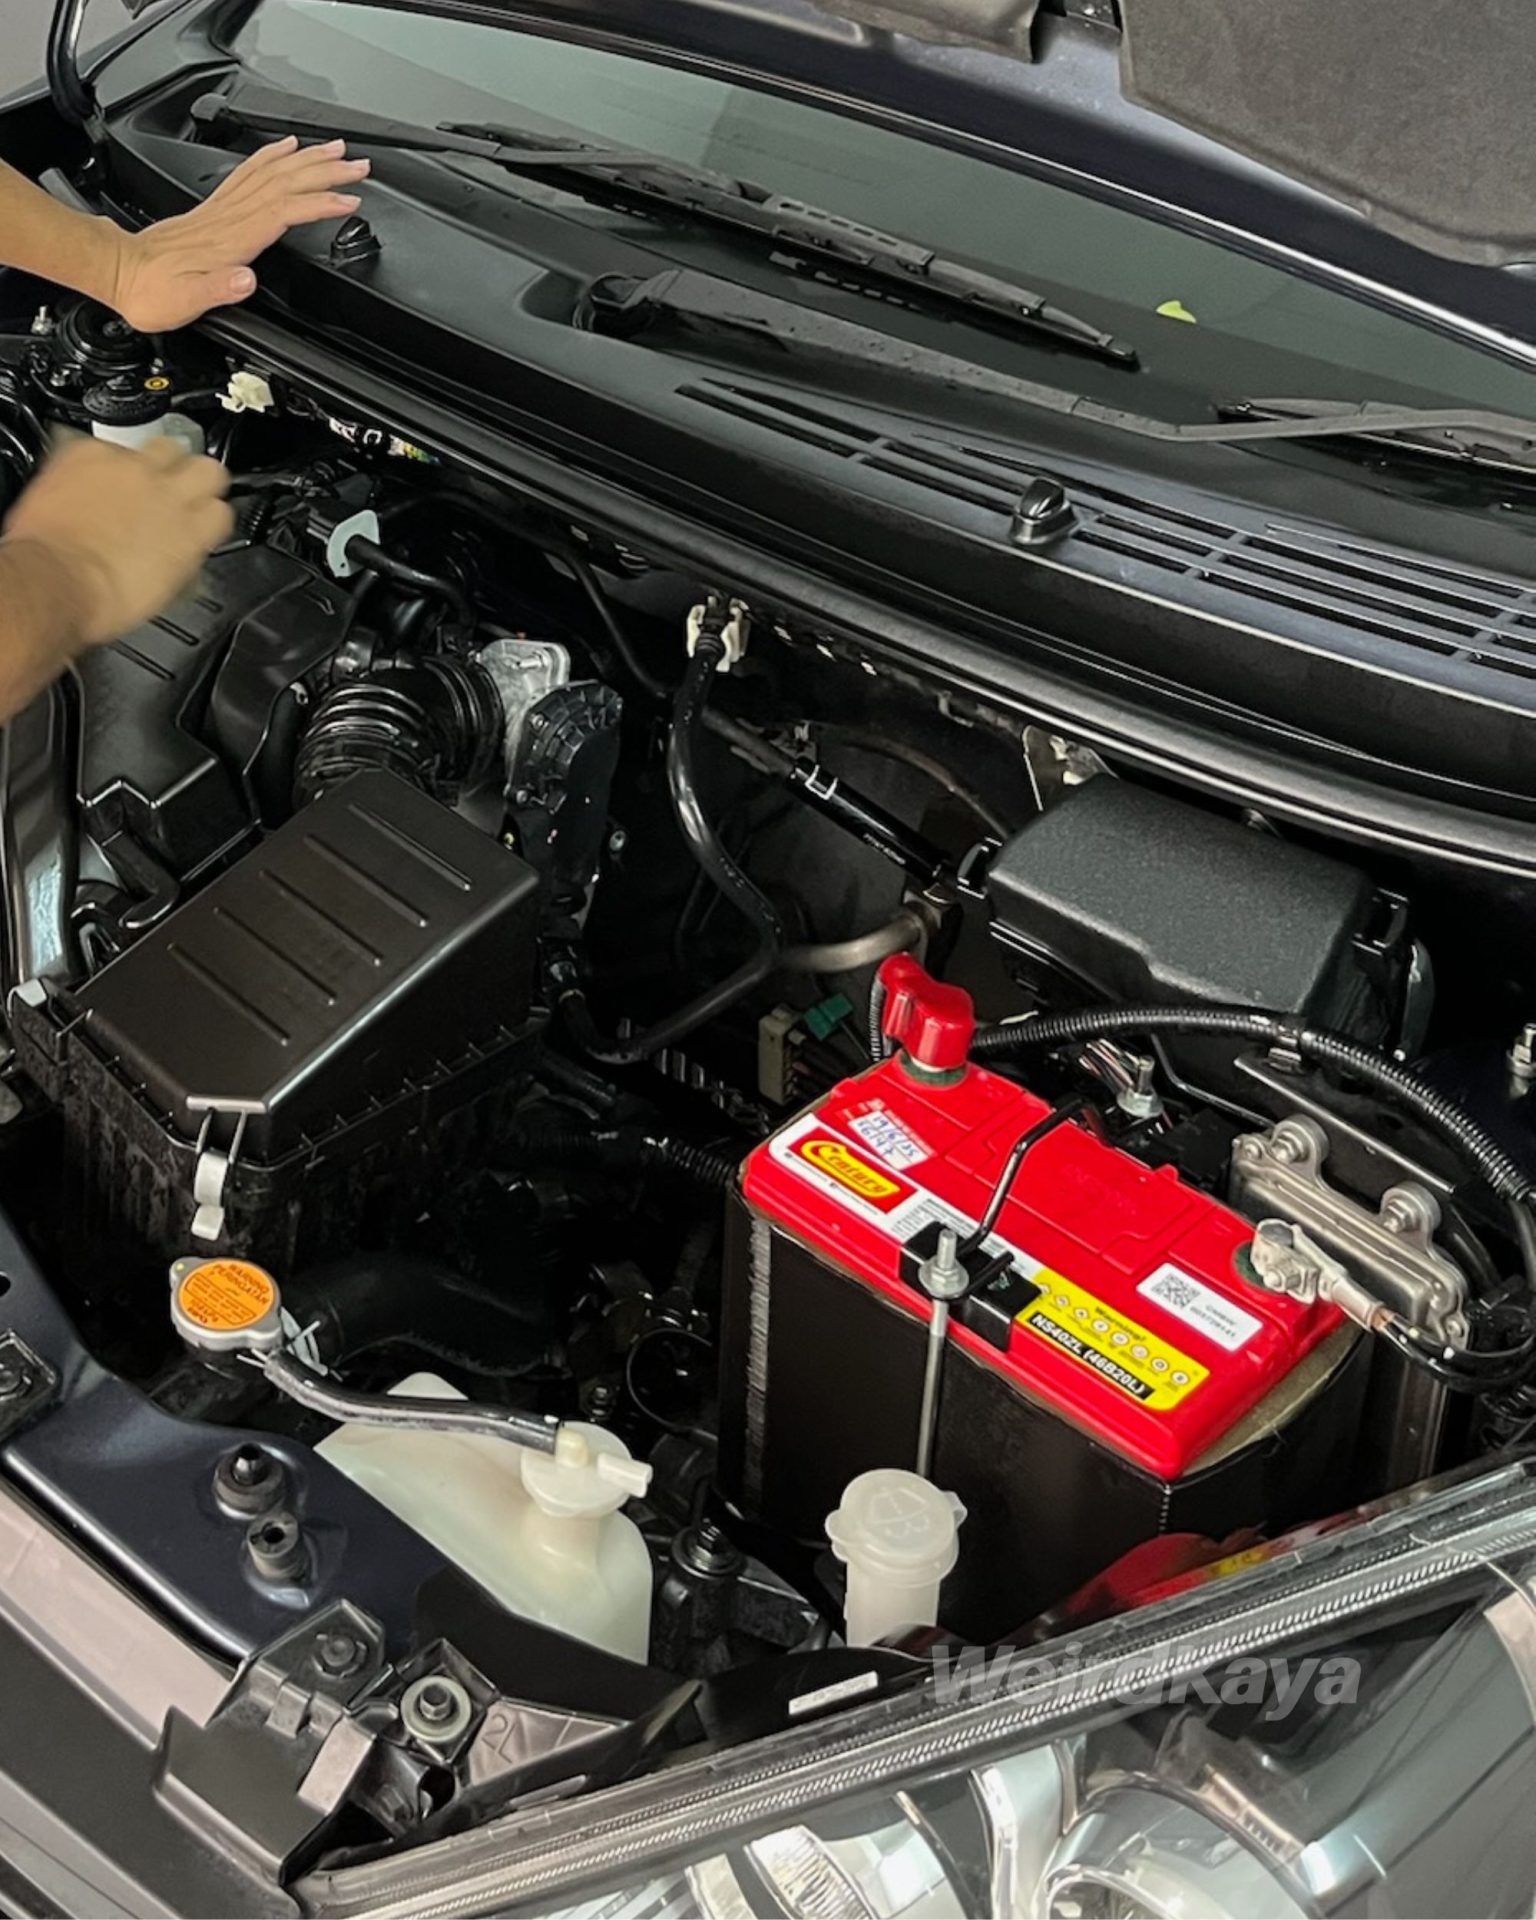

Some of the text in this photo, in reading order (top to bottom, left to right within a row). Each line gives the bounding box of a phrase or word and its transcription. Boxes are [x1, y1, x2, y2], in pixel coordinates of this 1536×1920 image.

[806, 1142, 888, 1194] Century
[211, 1263, 268, 1305] PERINGATAN
[228, 1264, 270, 1294] WARNING
[1094, 1306, 1147, 1342] Warning!
[1031, 1314, 1083, 1355] NS40ZL
[1082, 1348, 1146, 1395] (46B20L)
